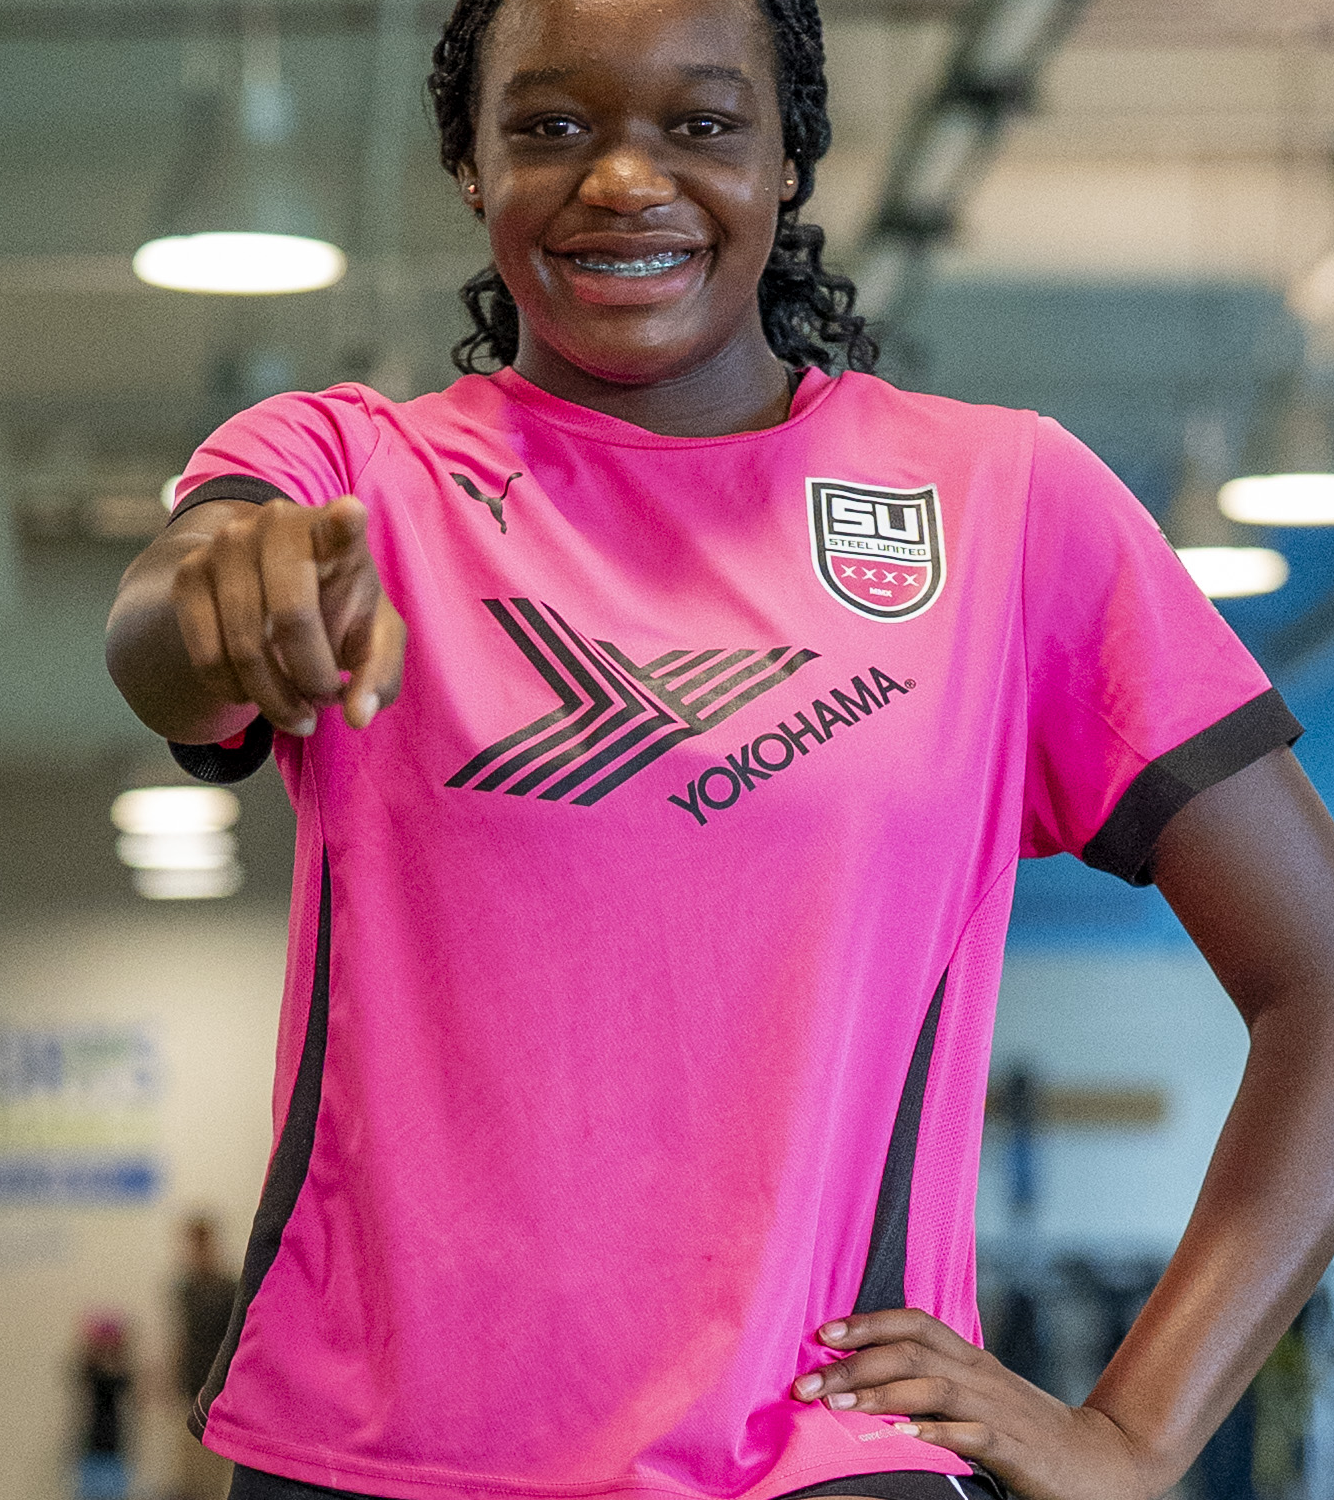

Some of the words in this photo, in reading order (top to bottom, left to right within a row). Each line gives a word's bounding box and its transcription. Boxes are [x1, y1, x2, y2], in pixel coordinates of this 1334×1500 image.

[830, 496, 921, 542] SU
[828, 538, 874, 550] STEEL
[876, 542, 927, 557] UNITED
[666, 666, 910, 827] YOKOHAMA
